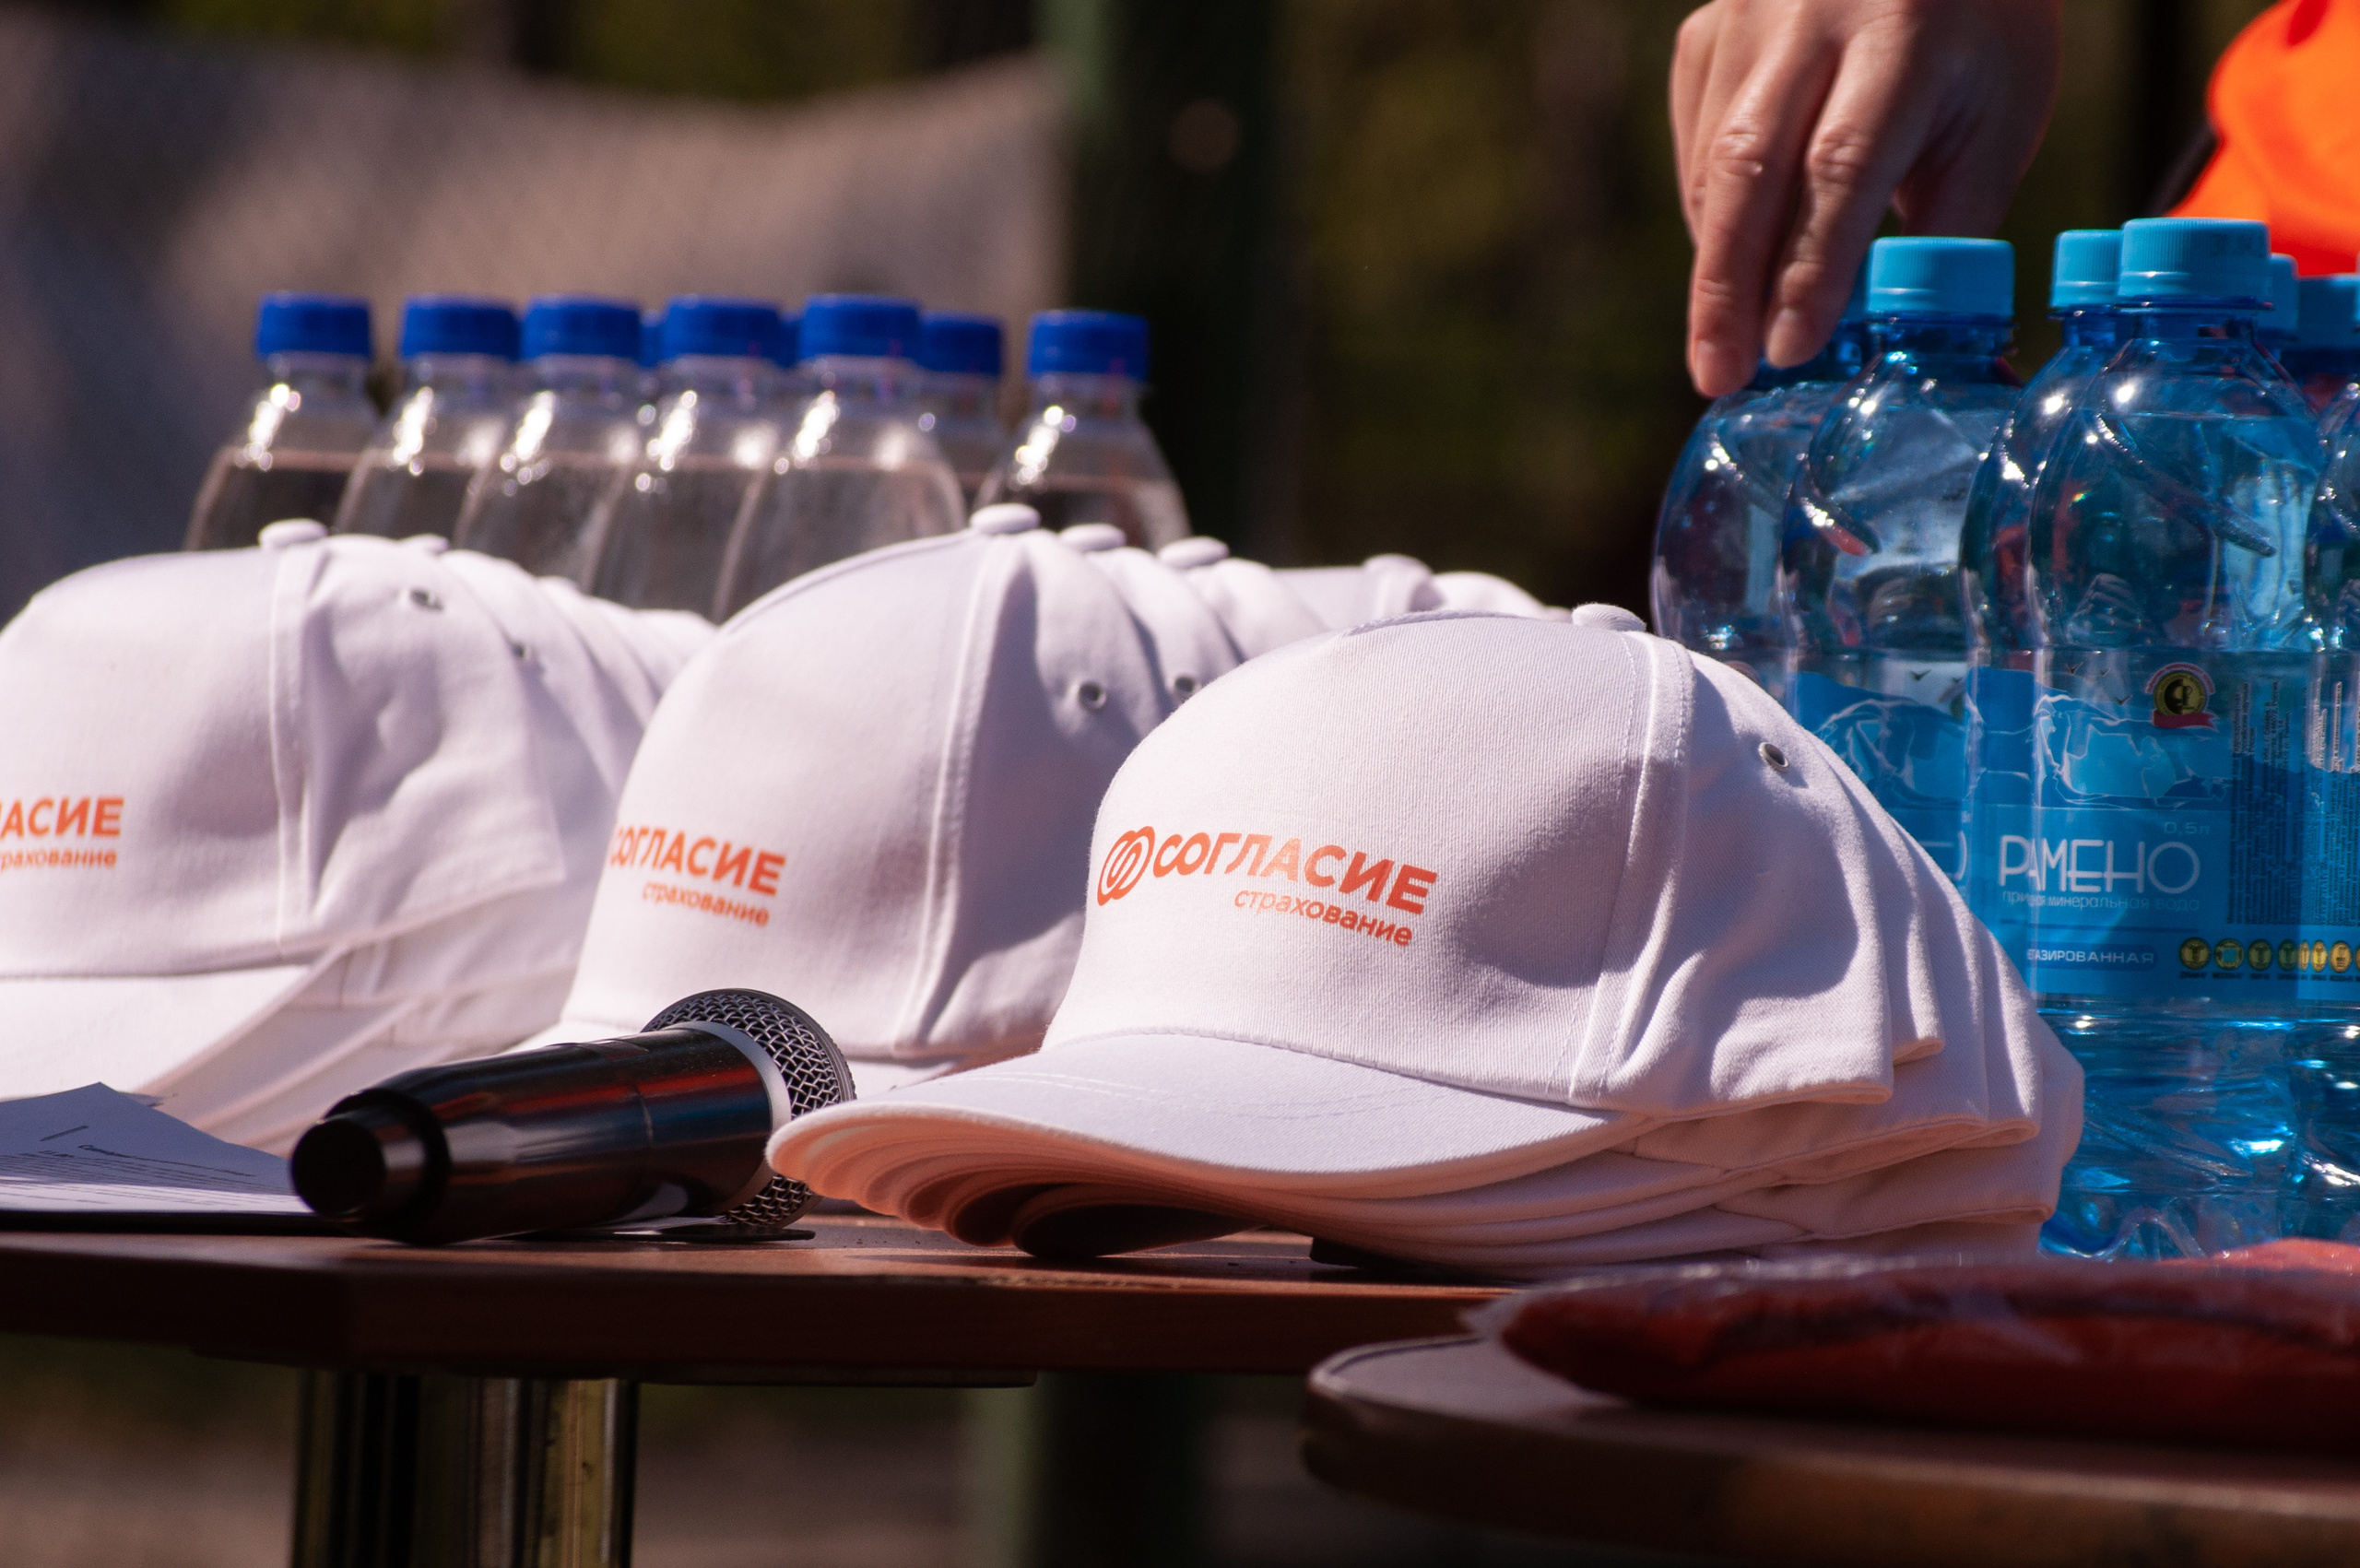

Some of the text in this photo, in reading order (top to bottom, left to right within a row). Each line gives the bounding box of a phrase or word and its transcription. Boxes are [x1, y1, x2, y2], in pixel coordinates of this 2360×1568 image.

[0, 796, 125, 841] АСИЕ
[0, 851, 118, 873] рахование
[1152, 831, 1439, 916] СОГЛАСИЕ
[642, 881, 769, 927] страхование
[1233, 890, 1414, 947] страхование
[2026, 949, 2154, 963] ЕГАЗИРОВАННАЯ
